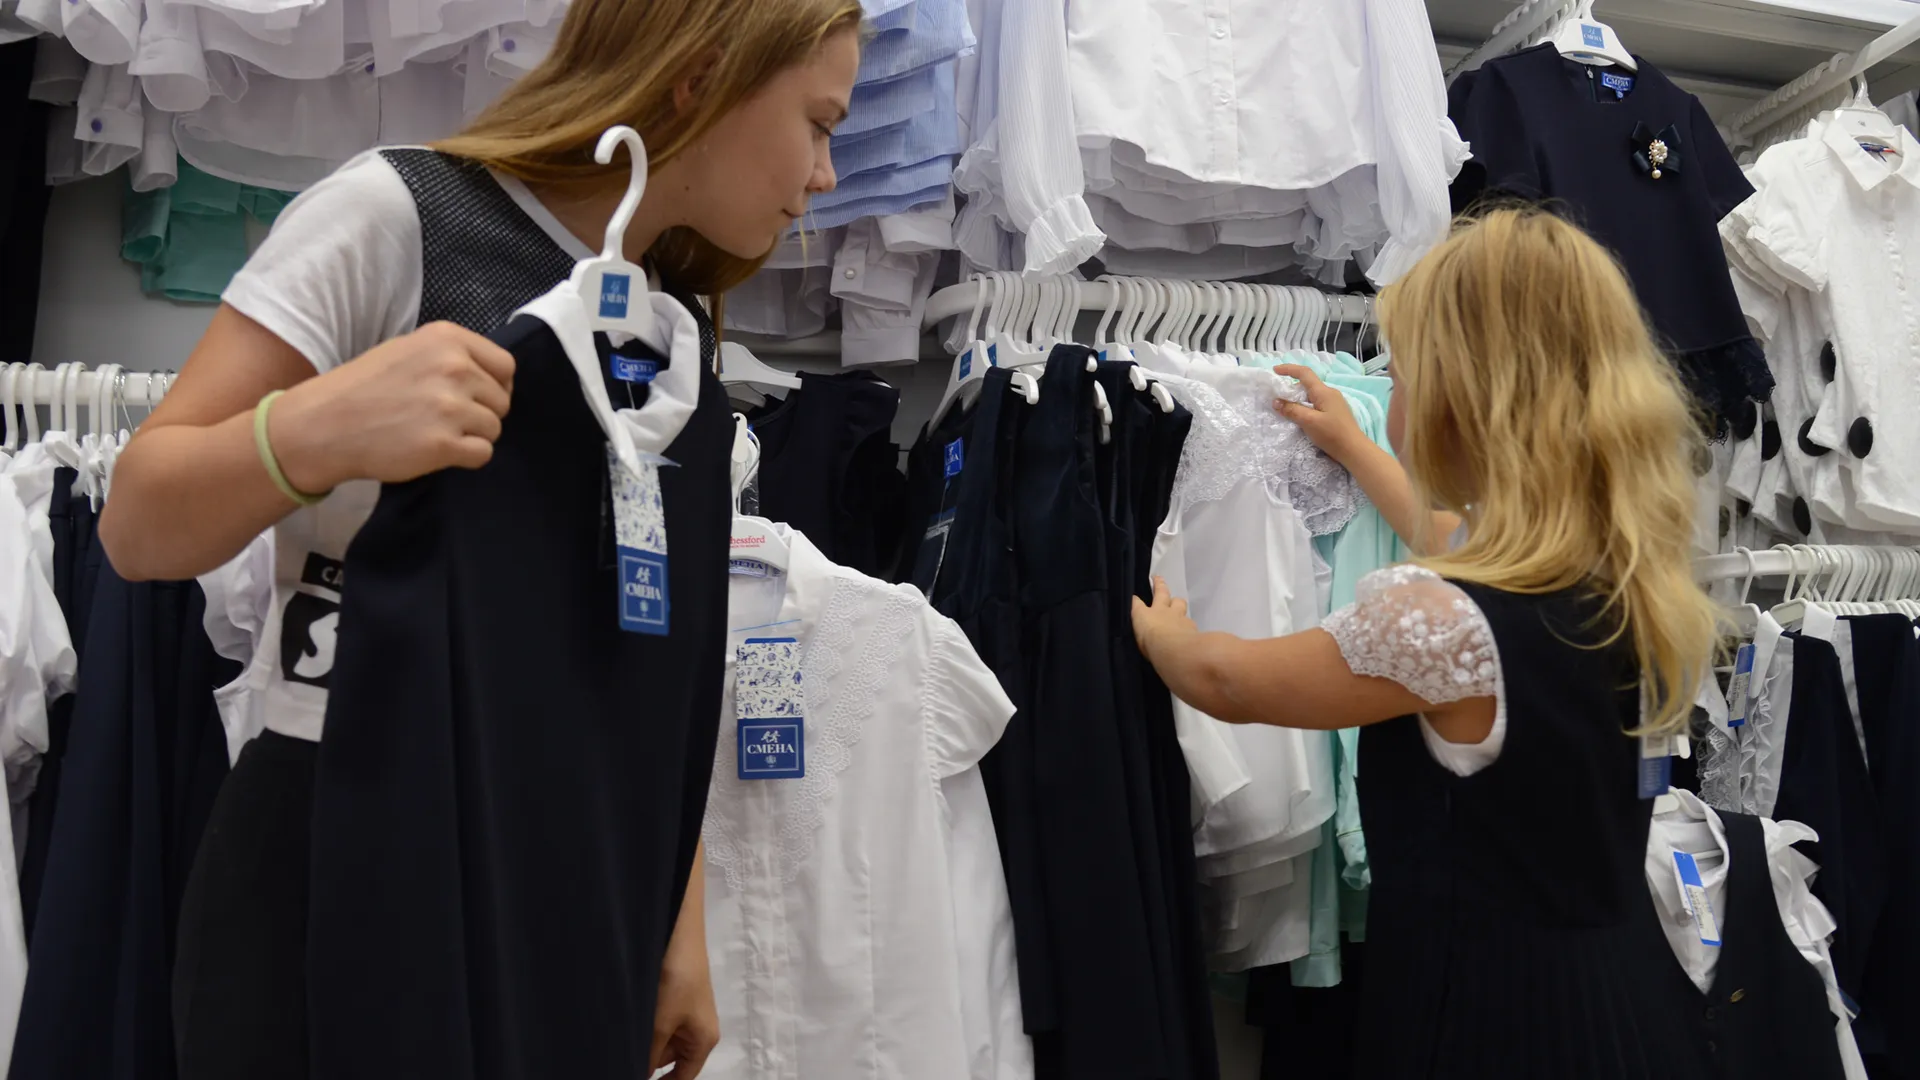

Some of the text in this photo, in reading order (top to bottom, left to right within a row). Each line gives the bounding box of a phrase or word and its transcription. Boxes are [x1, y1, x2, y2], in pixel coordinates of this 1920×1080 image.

[730, 535, 766, 544] hessford
[730, 559, 764, 570] МЕНА
[625, 582, 662, 601] СМЕНА
[746, 743, 796, 755] СМЕНА
